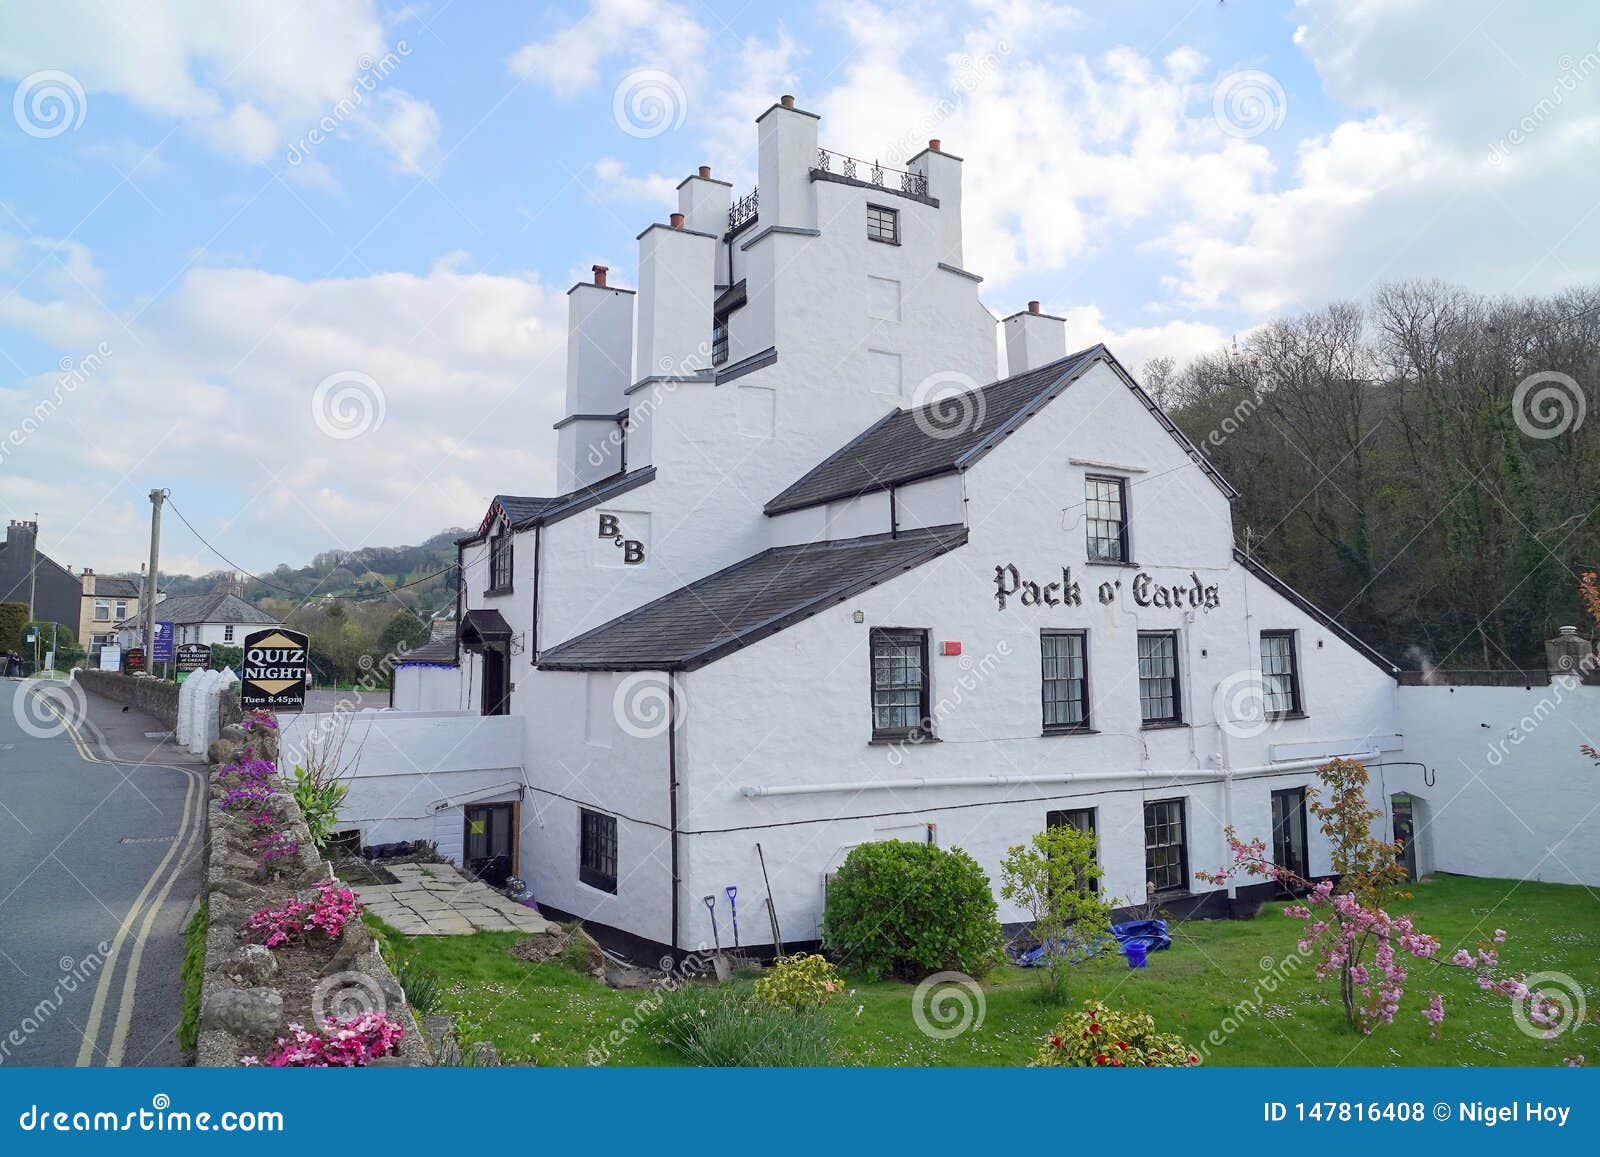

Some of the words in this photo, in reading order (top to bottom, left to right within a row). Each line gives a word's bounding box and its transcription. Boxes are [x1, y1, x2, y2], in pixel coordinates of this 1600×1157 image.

[994, 562, 1083, 612] Pack
[1132, 571, 1221, 614] Cards
[247, 649, 305, 667] QUIZ
[244, 667, 306, 679] NIGHT
[243, 696, 266, 704] Tues
[268, 695, 303, 705] 8.45pm
